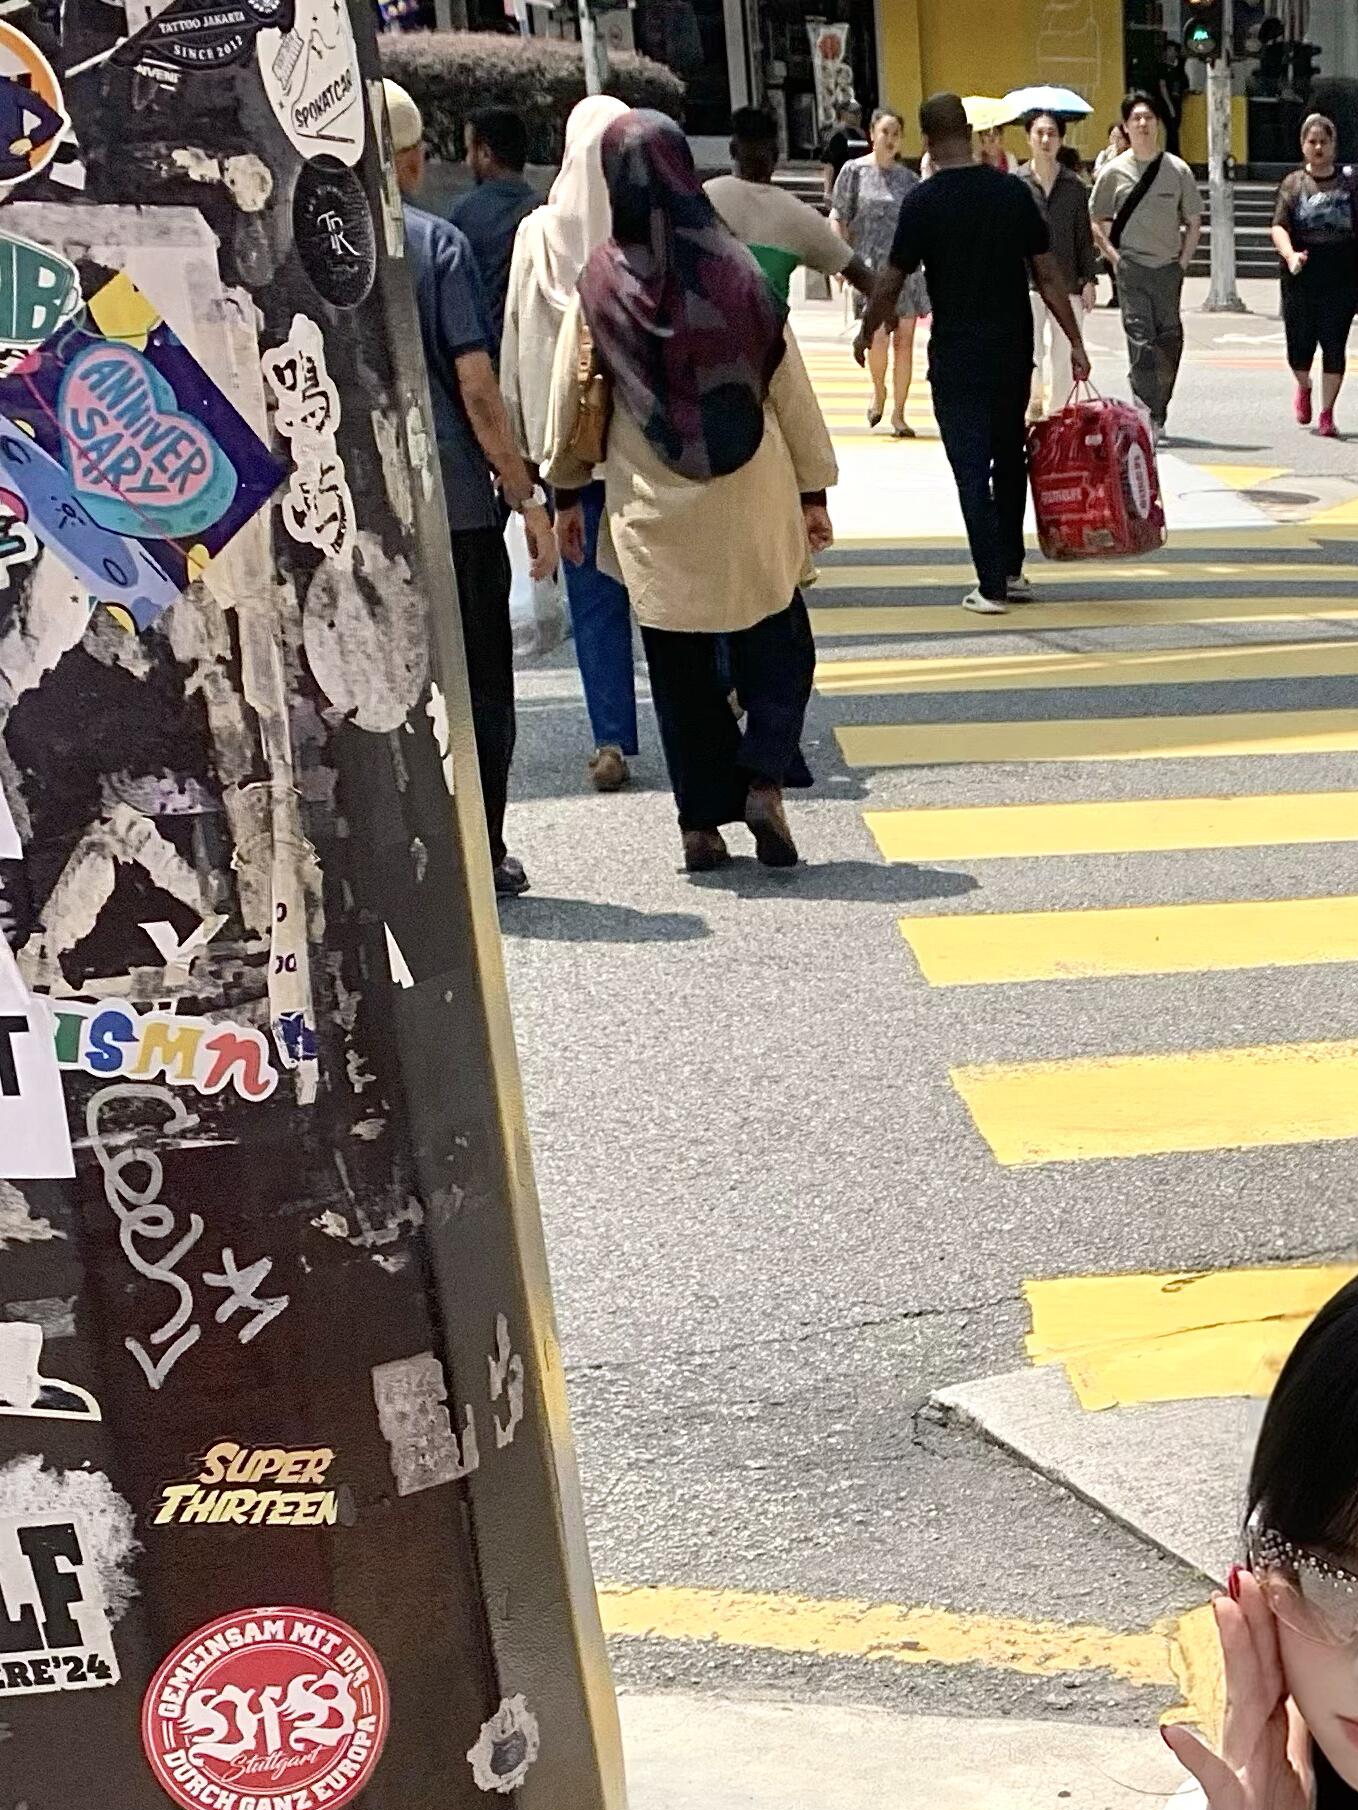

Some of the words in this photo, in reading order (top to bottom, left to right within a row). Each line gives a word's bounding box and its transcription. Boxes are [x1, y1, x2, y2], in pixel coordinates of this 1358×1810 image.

[158, 17, 202, 34] TATTOO
[202, 11, 246, 28] JAKARTA
[173, 43, 215, 60] SINCE
[215, 34, 243, 58] 2012
[197, 1441, 337, 1485] SUPER
[152, 1483, 339, 1526] THIRTEEN
[0, 1653, 113, 1690] RE'24
[157, 1619, 286, 1720] GEMEINSAM
[288, 1620, 343, 1656] MIT
[334, 1644, 370, 1689] DIR
[220, 1744, 324, 1783] Stuttgart
[310, 1714, 377, 1803] EUROPA
